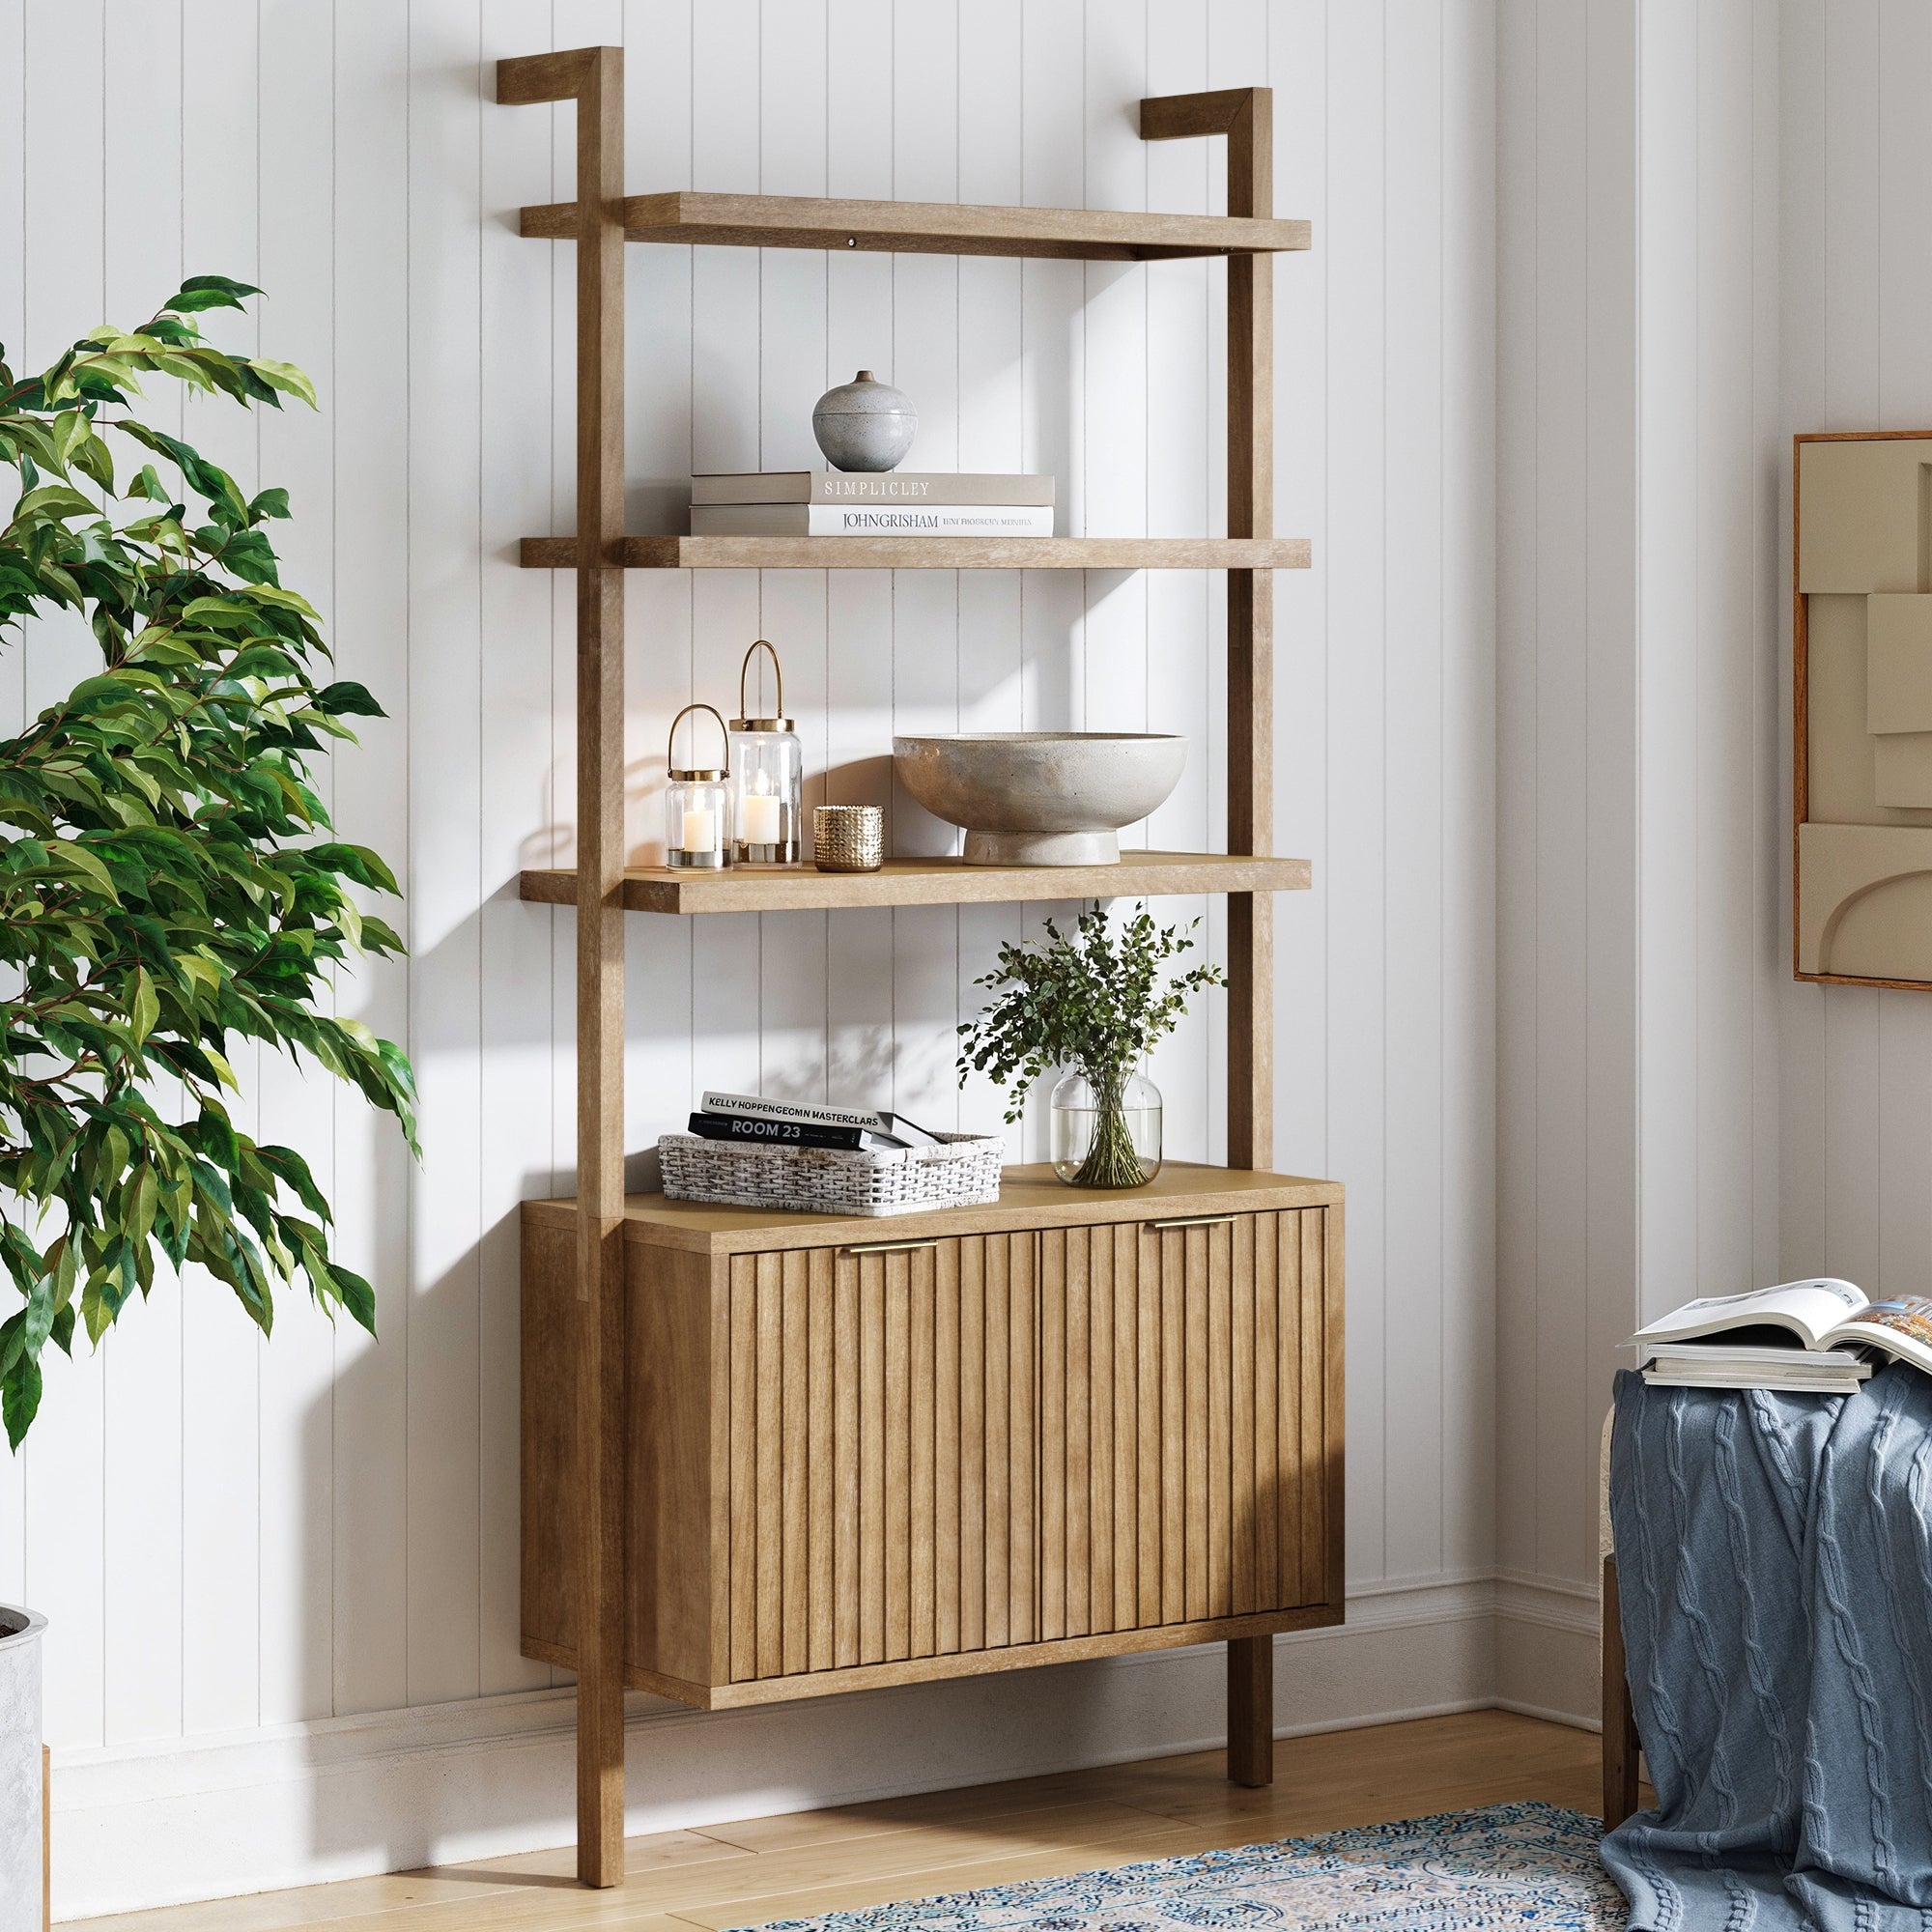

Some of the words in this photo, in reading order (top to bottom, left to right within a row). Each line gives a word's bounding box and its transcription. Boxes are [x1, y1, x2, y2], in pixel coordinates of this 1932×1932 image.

[824, 481, 930, 497] SIMPLICLEY
[708, 1096, 738, 1109] KELLY
[731, 1120, 780, 1137] ROOM
[781, 1124, 802, 1138] 23
